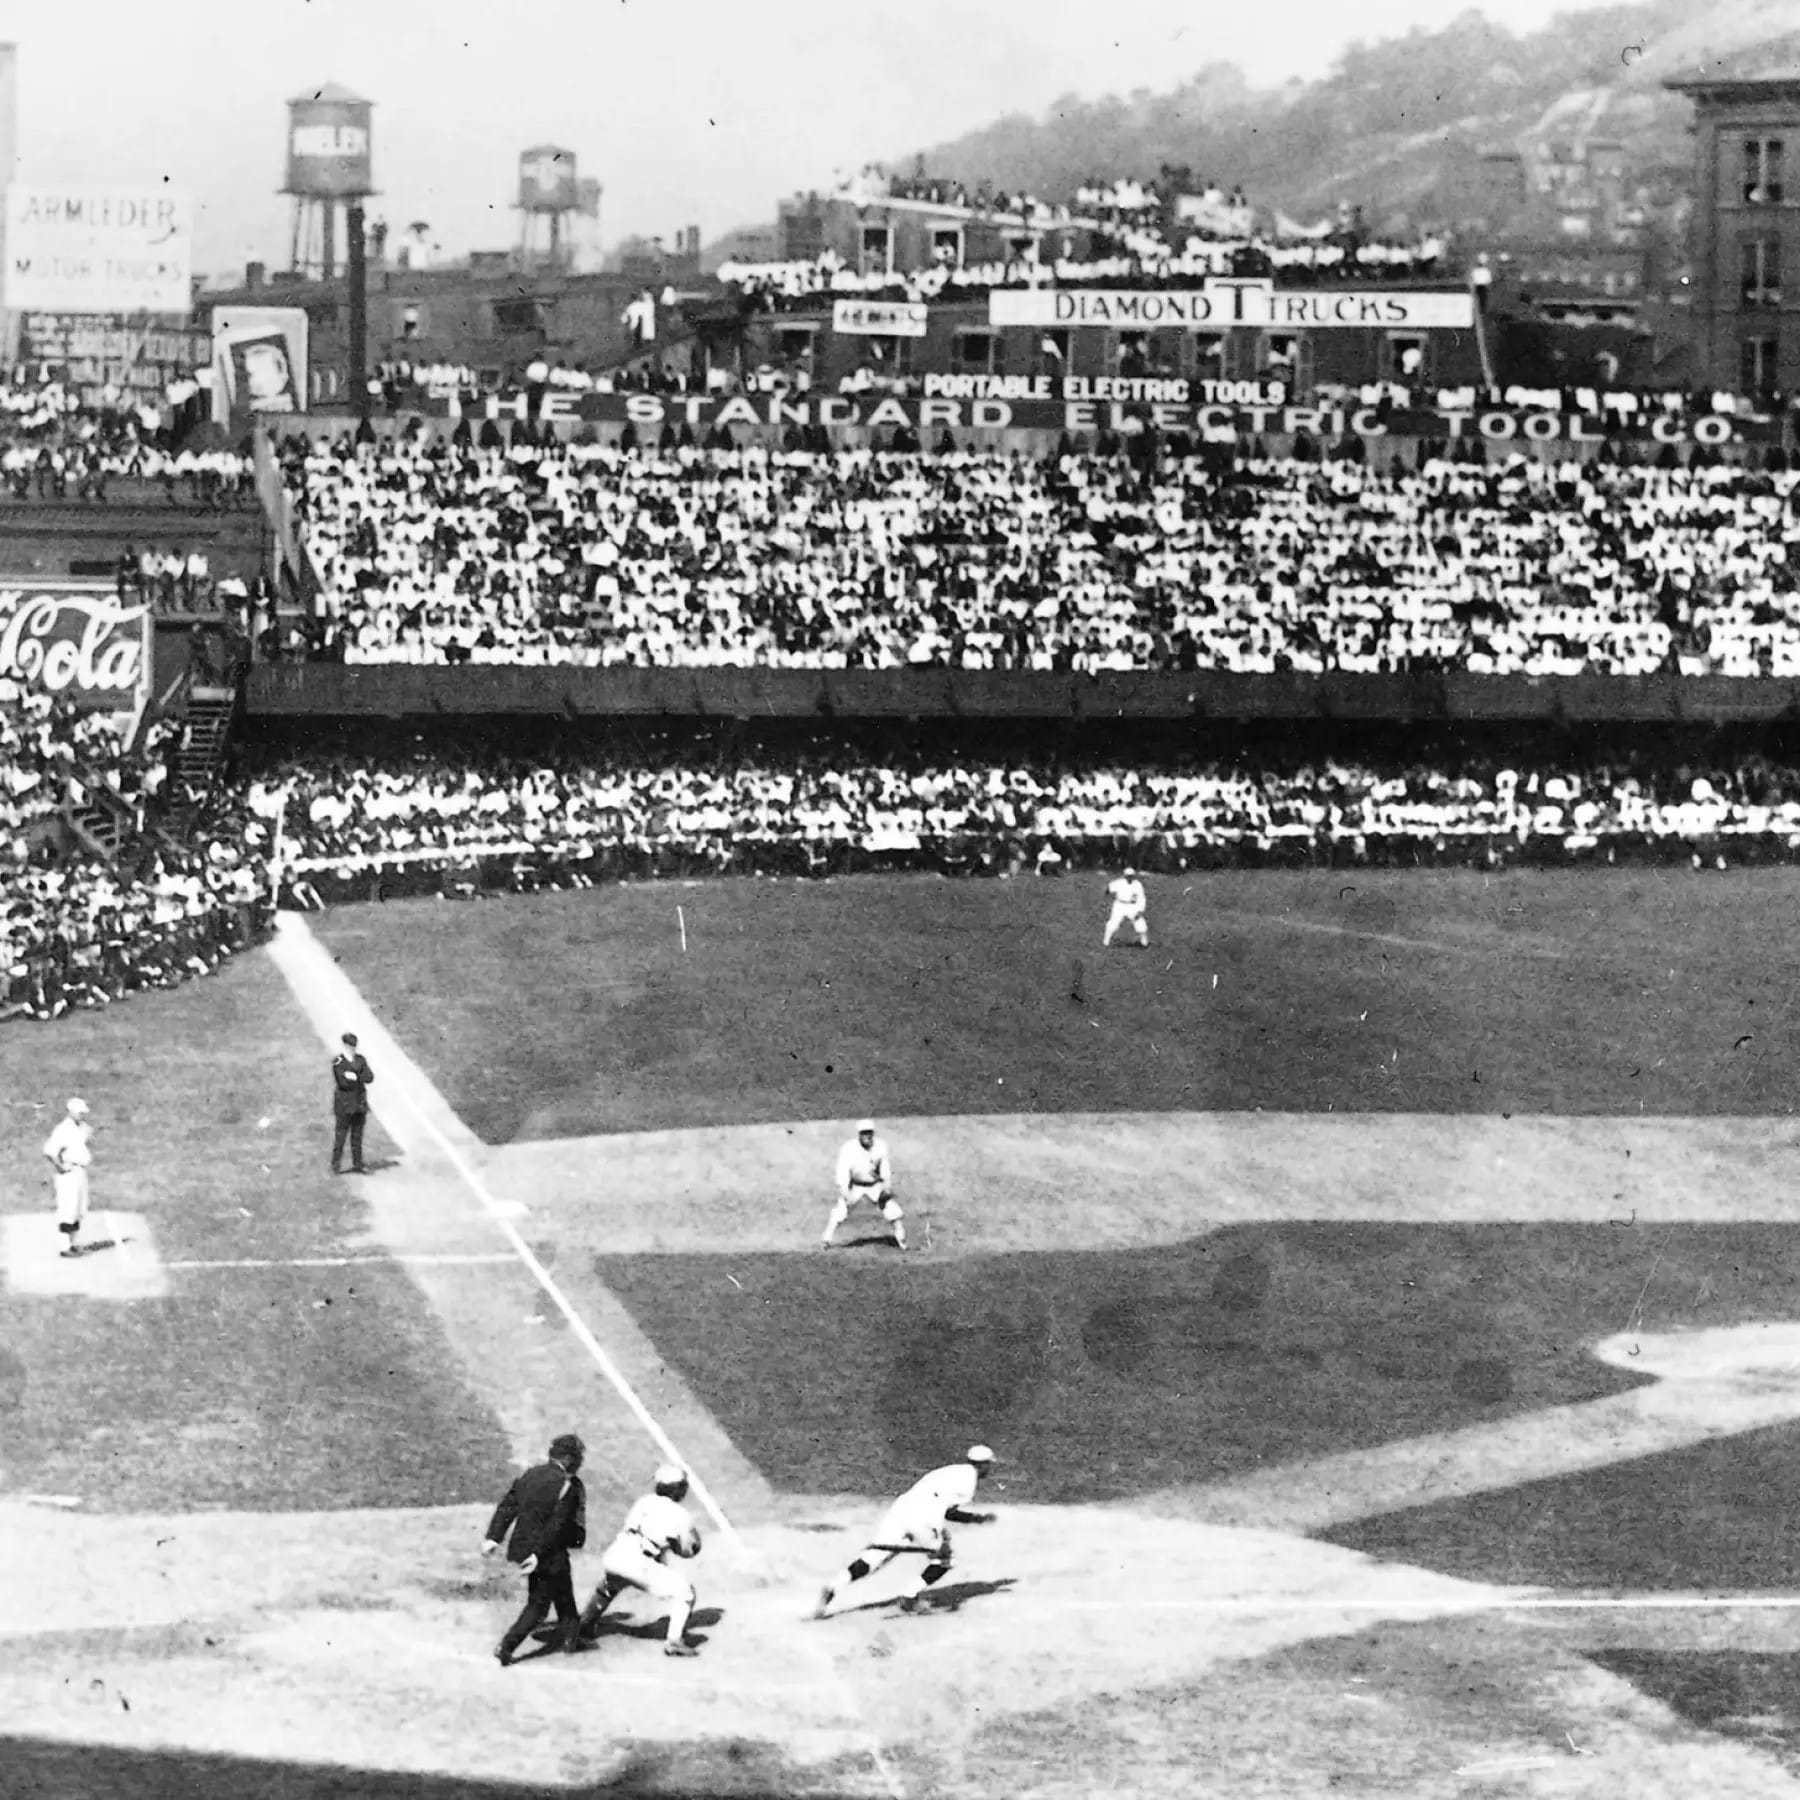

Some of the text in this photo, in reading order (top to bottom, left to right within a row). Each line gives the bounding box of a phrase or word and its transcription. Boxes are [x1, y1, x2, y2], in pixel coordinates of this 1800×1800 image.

[1054, 282, 1408, 322] DIAMOND T TRUCKS
[924, 373, 1286, 405] PORTABLE ELECTRIC TOOLS
[626, 394, 1013, 429] STANDARD
[1064, 402, 1388, 436] ELECTRIC
[1437, 411, 1606, 441] TOOL
[1652, 415, 1744, 444] CO.
[0, 594, 150, 691] Cola
